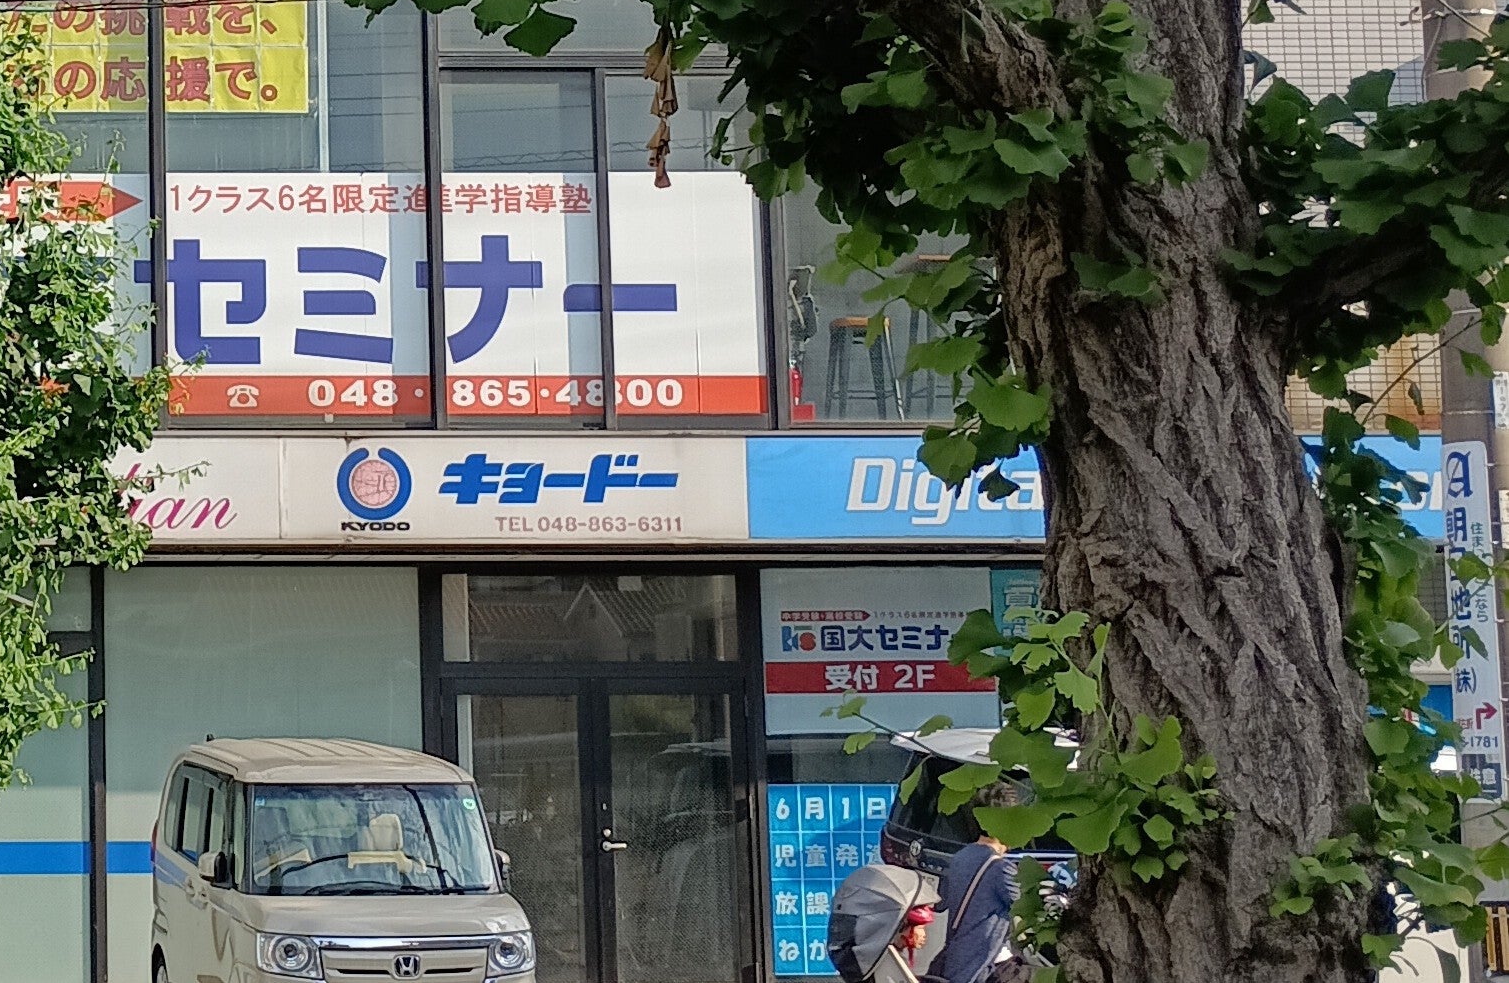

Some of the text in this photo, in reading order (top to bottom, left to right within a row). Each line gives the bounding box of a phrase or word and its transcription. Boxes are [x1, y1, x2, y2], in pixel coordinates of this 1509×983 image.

[170, 183, 592, 214] 1クラス6名限定進学指導塾
[438, 453, 679, 504] キョードー
[341, 521, 411, 531] KYODO
[495, 516, 682, 532] TEL 048-863-6311
[820, 624, 958, 651] 国大セミナ
[824, 665, 936, 690] 受付 2F
[775, 797, 887, 820] 6月1日
